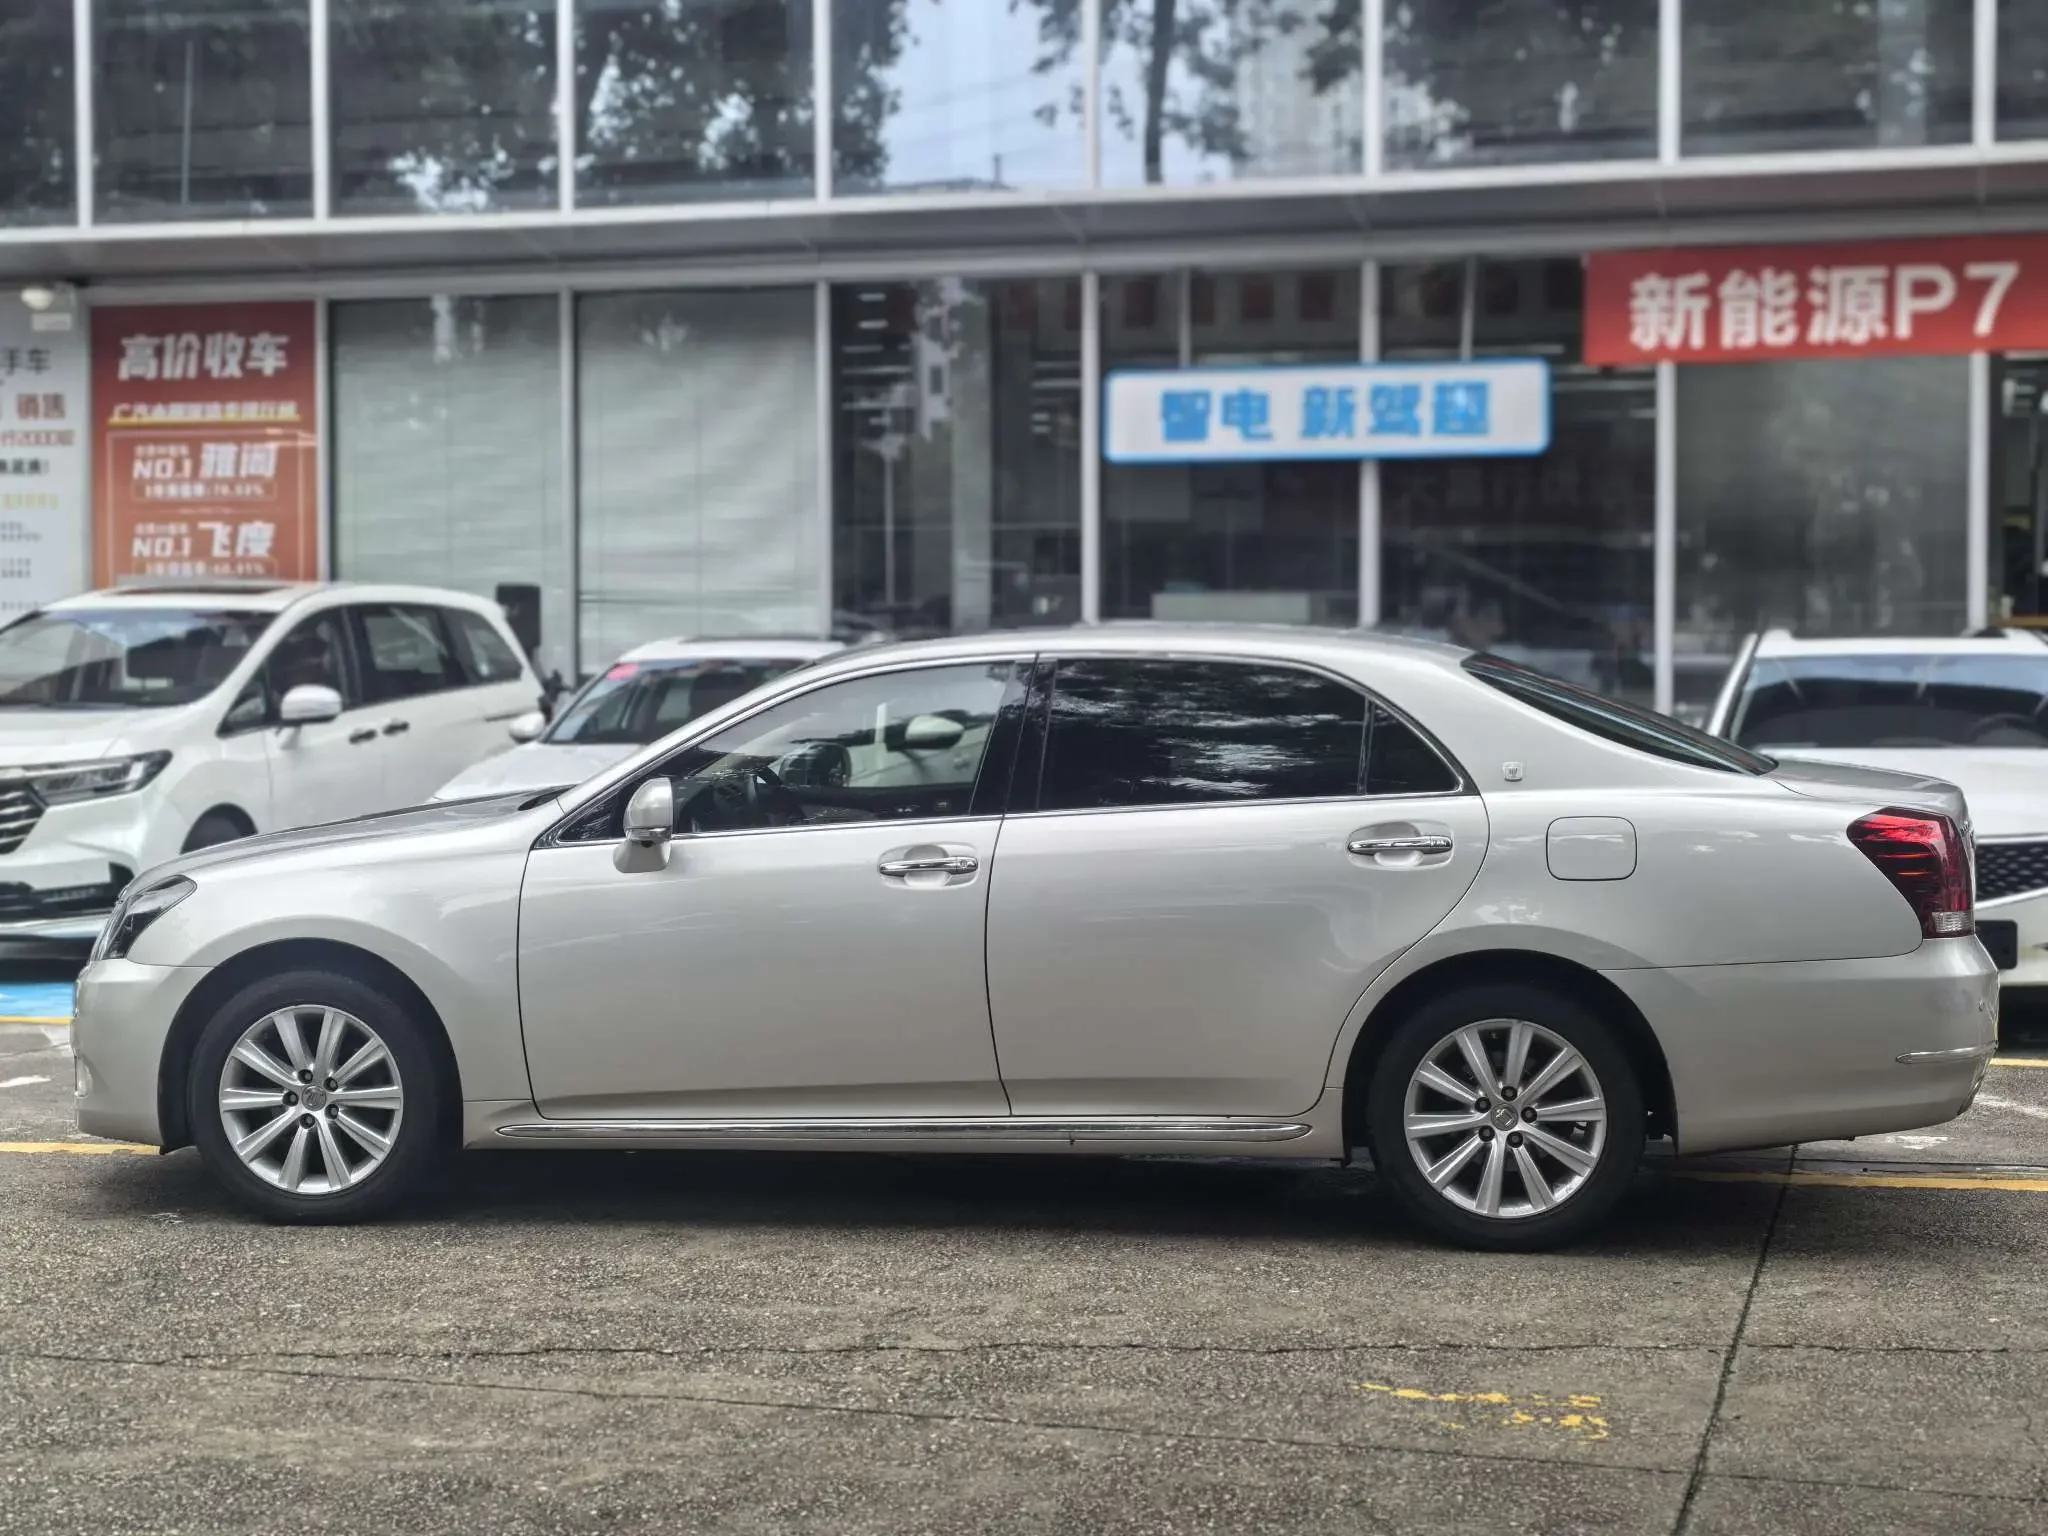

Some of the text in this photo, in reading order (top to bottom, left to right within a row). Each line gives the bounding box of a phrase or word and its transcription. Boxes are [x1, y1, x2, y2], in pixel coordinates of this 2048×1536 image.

[1629, 261, 2020, 350] 新能源P7
[117, 332, 290, 380] 高价收车
[132, 457, 192, 480] NO.1
[131, 520, 276, 558] NO.1 飞度
